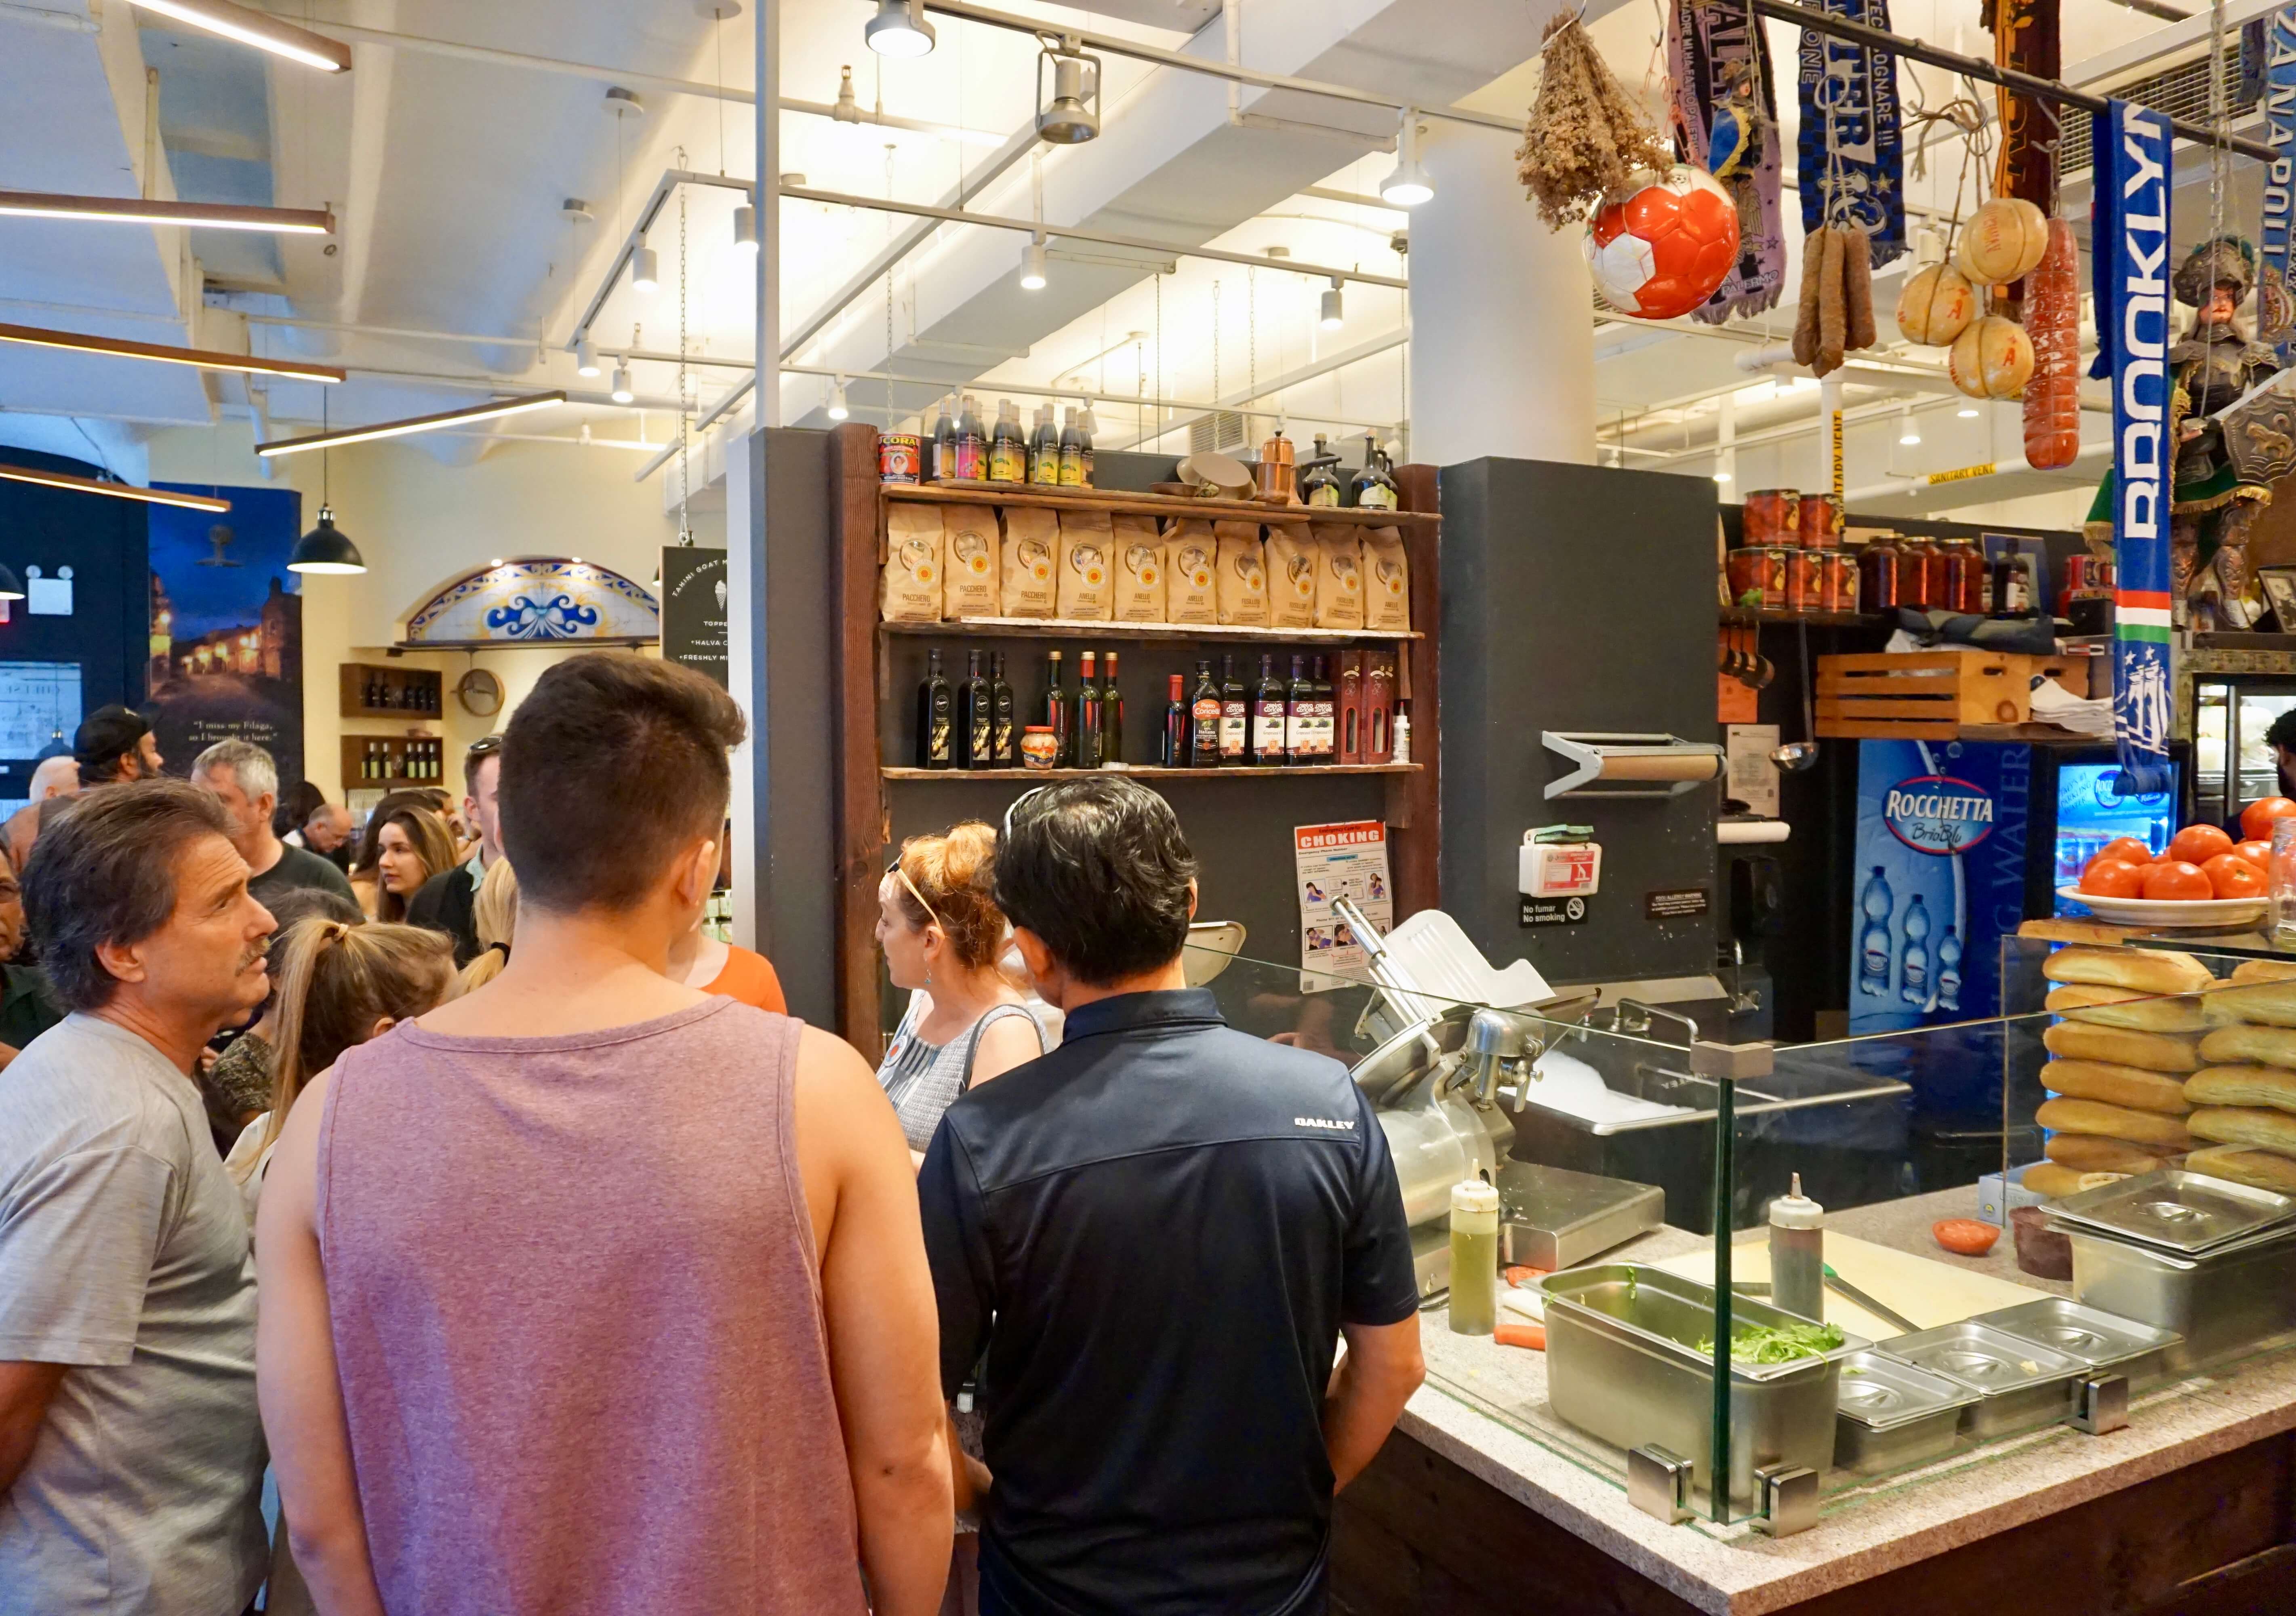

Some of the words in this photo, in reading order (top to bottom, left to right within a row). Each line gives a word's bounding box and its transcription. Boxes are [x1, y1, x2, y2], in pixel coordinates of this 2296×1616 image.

[1873, 48, 1892, 124] OGNARE
[1721, 269, 1779, 296] PALERMO
[883, 437, 915, 445] CORA
[1930, 468, 1969, 484] SANITARY
[672, 572, 694, 597] TAHINI
[696, 560, 718, 573] GOAT
[902, 593, 930, 602] PACCHERO
[1021, 591, 1047, 599] PACCHERO
[1886, 790, 1993, 822] ROCCHETTA
[1992, 746, 2031, 889] WATER
[1301, 830, 1379, 848] CHOKING
[1535, 913, 1565, 922] smoking
[1294, 1118, 1355, 1130] OAKLEY
